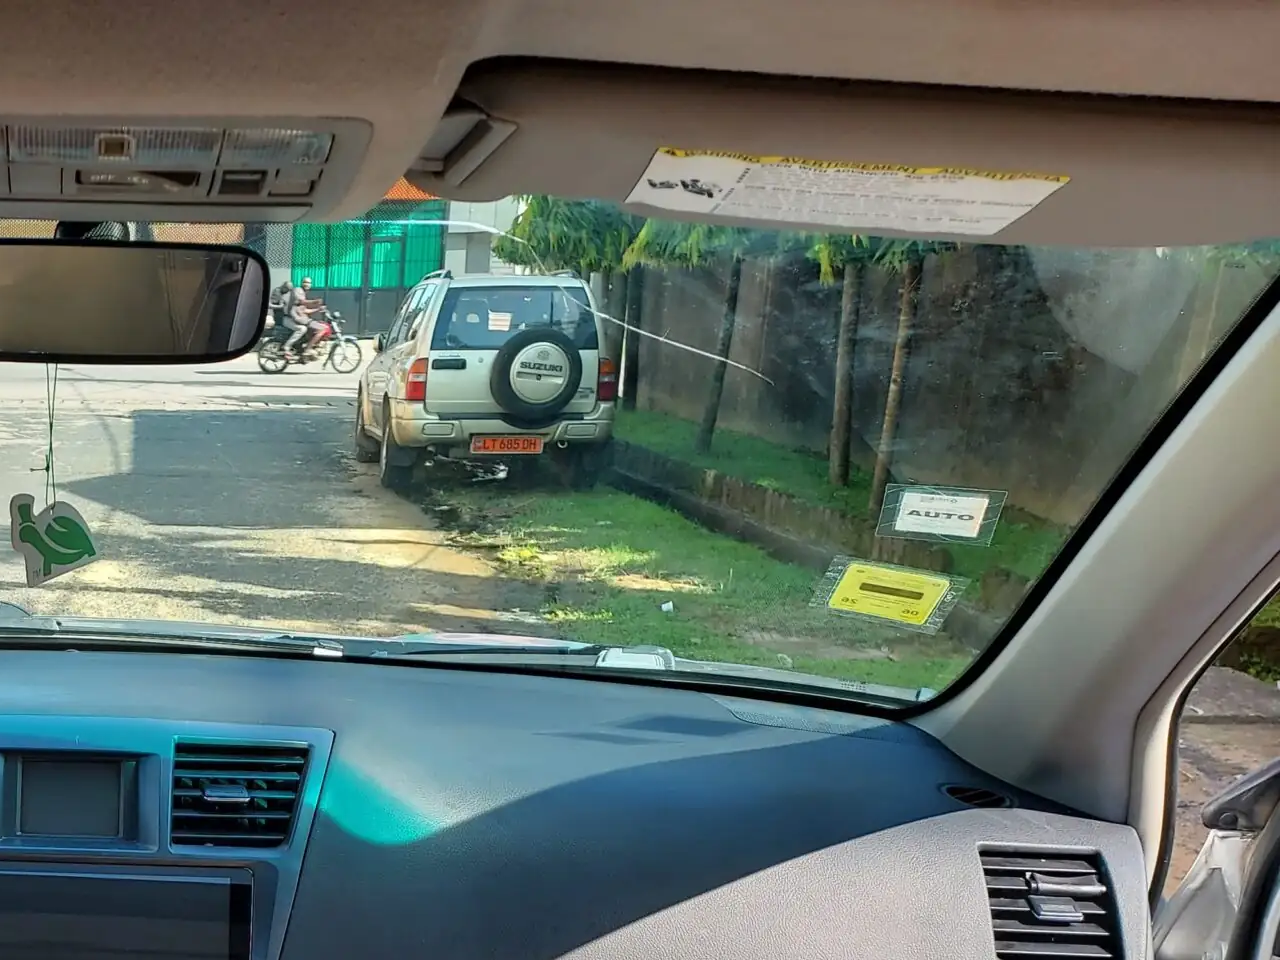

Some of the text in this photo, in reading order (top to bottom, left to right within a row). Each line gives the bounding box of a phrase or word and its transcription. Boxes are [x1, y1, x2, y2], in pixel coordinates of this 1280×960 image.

[519, 361, 564, 373] SUZUKI
[483, 438, 497, 450] LT
[499, 438, 520, 451] 685
[907, 509, 975, 521] AUTO
